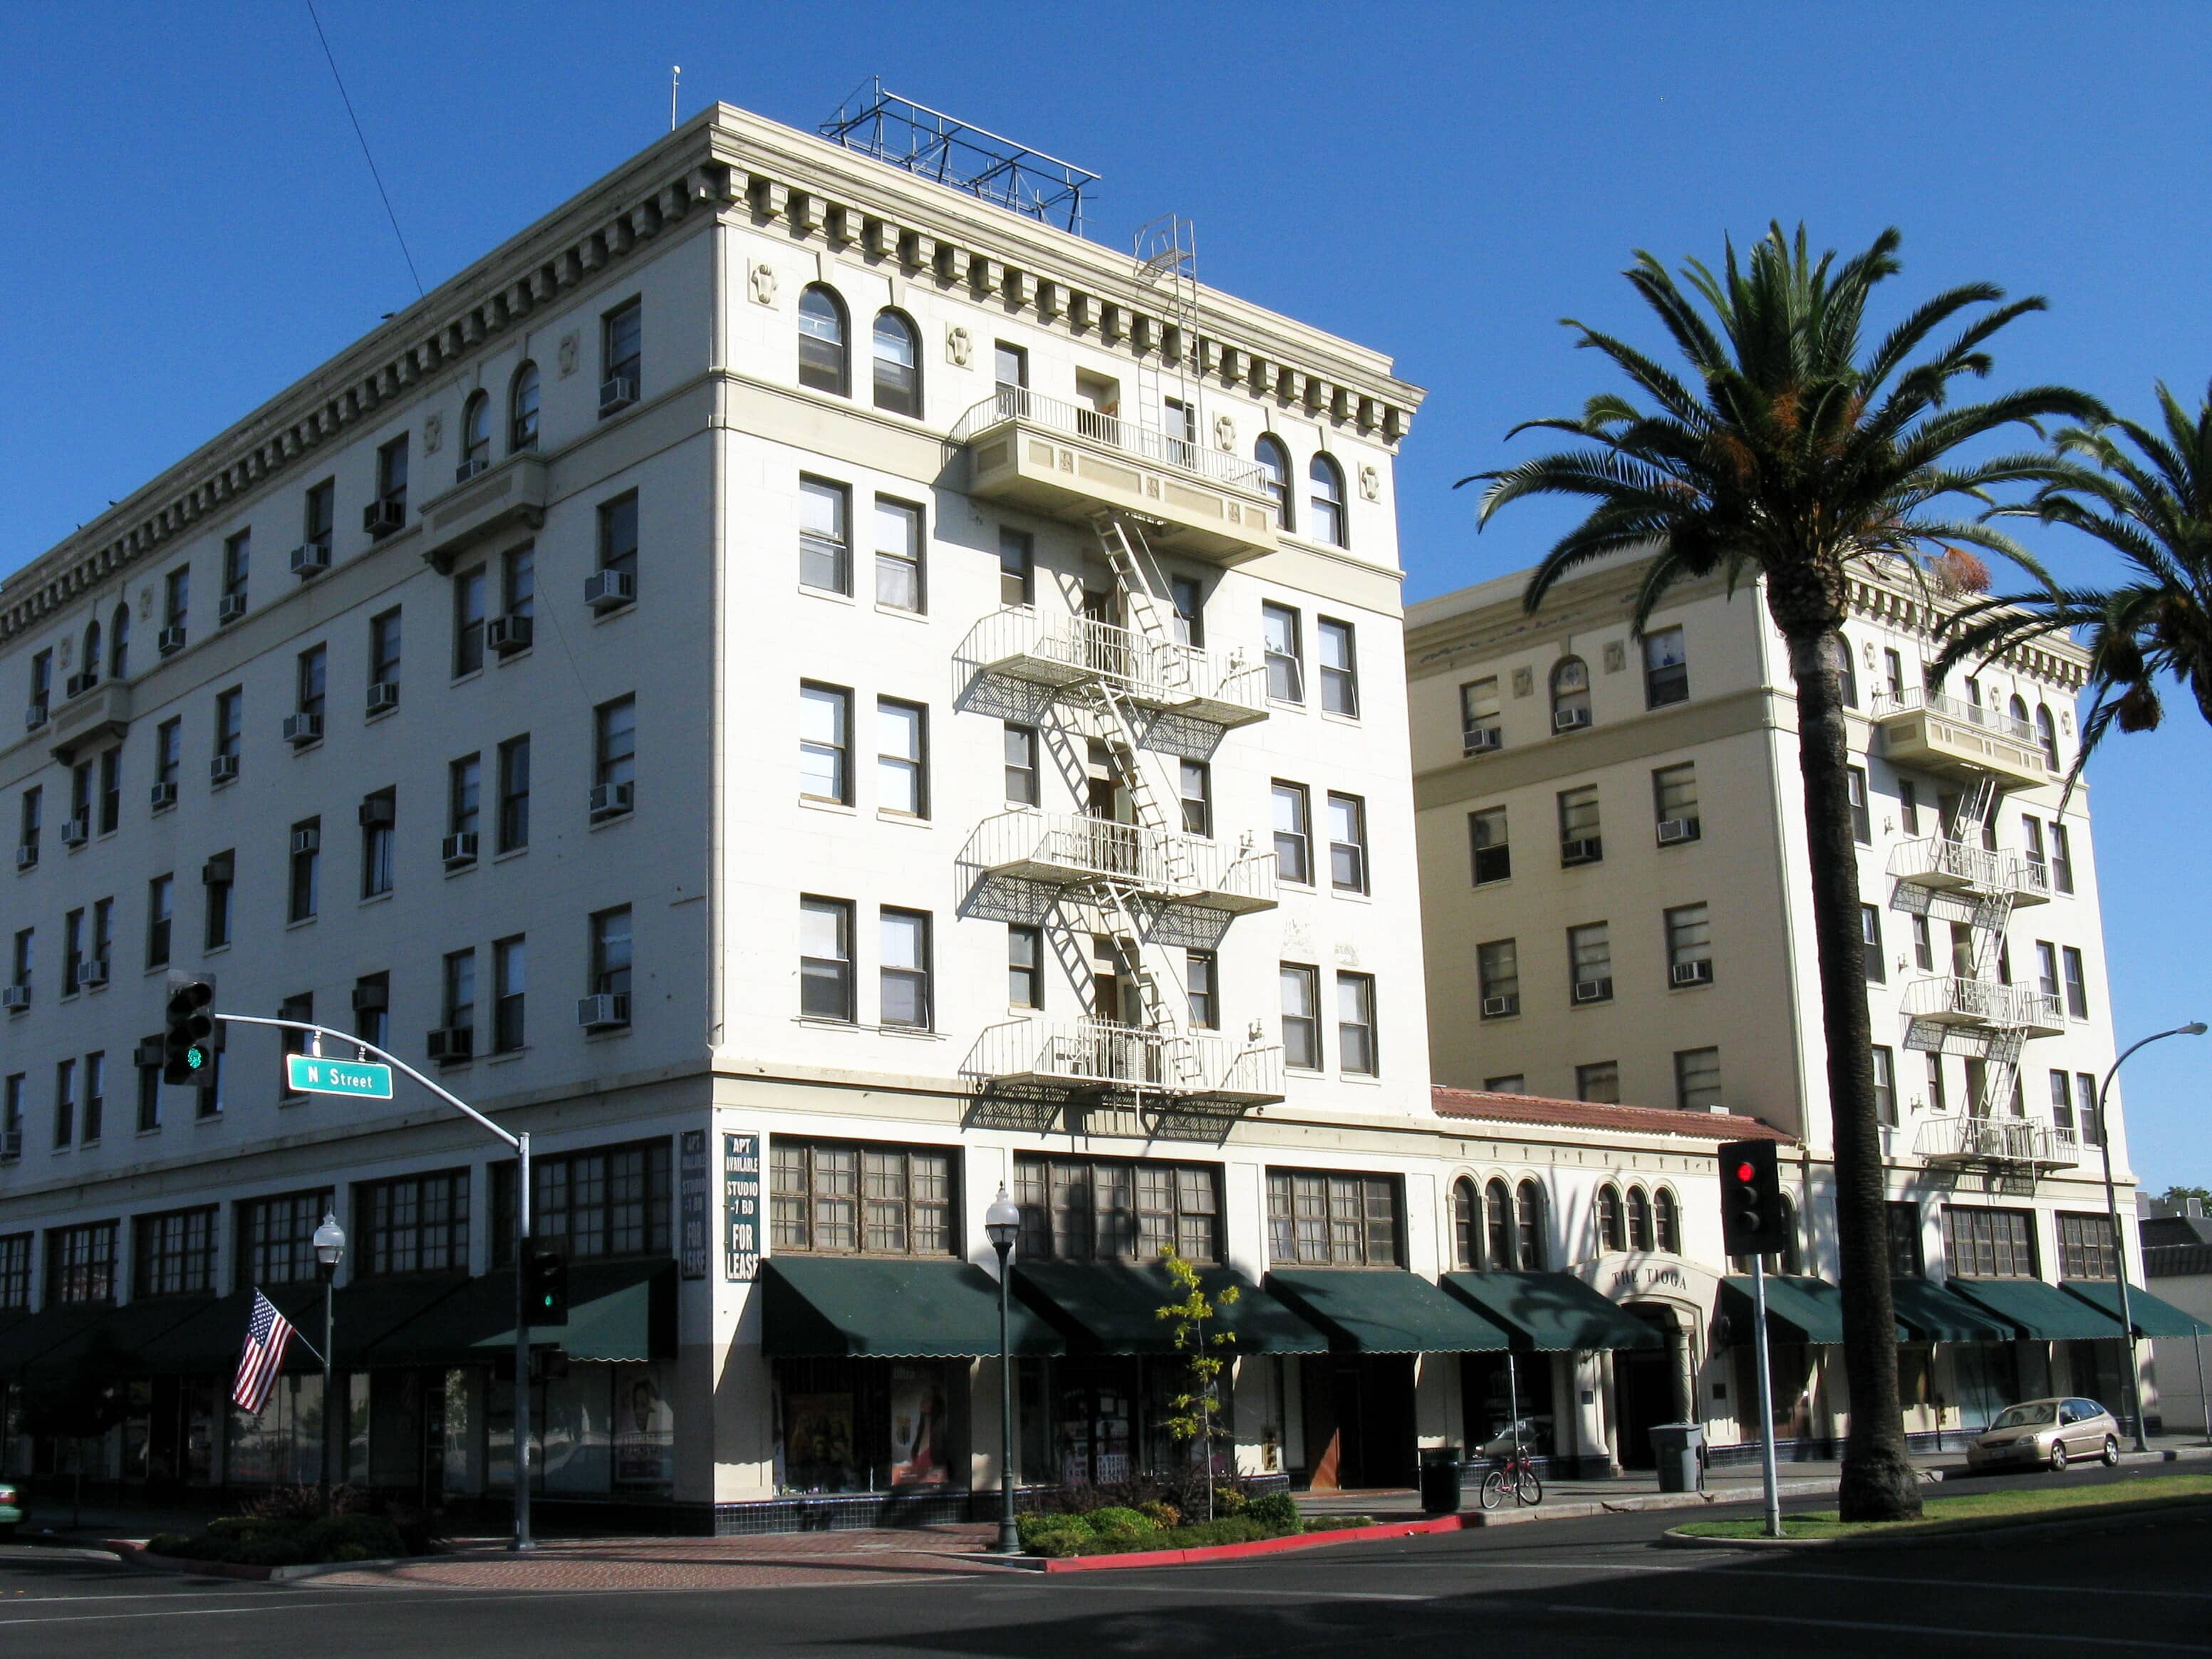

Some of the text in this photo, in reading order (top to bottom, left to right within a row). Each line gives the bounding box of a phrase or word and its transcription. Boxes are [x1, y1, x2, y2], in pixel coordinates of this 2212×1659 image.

[308, 1066, 373, 1088] N Street
[732, 1138, 752, 1154] APT
[726, 1155, 759, 1173] AVAILABLE
[727, 1180, 759, 1197] STUDIO
[730, 1199, 754, 1215] -1 BD
[732, 1223, 753, 1251] FOR
[727, 1252, 759, 1280] LEASE
[1611, 1268, 1688, 1291] THE TIOGA
